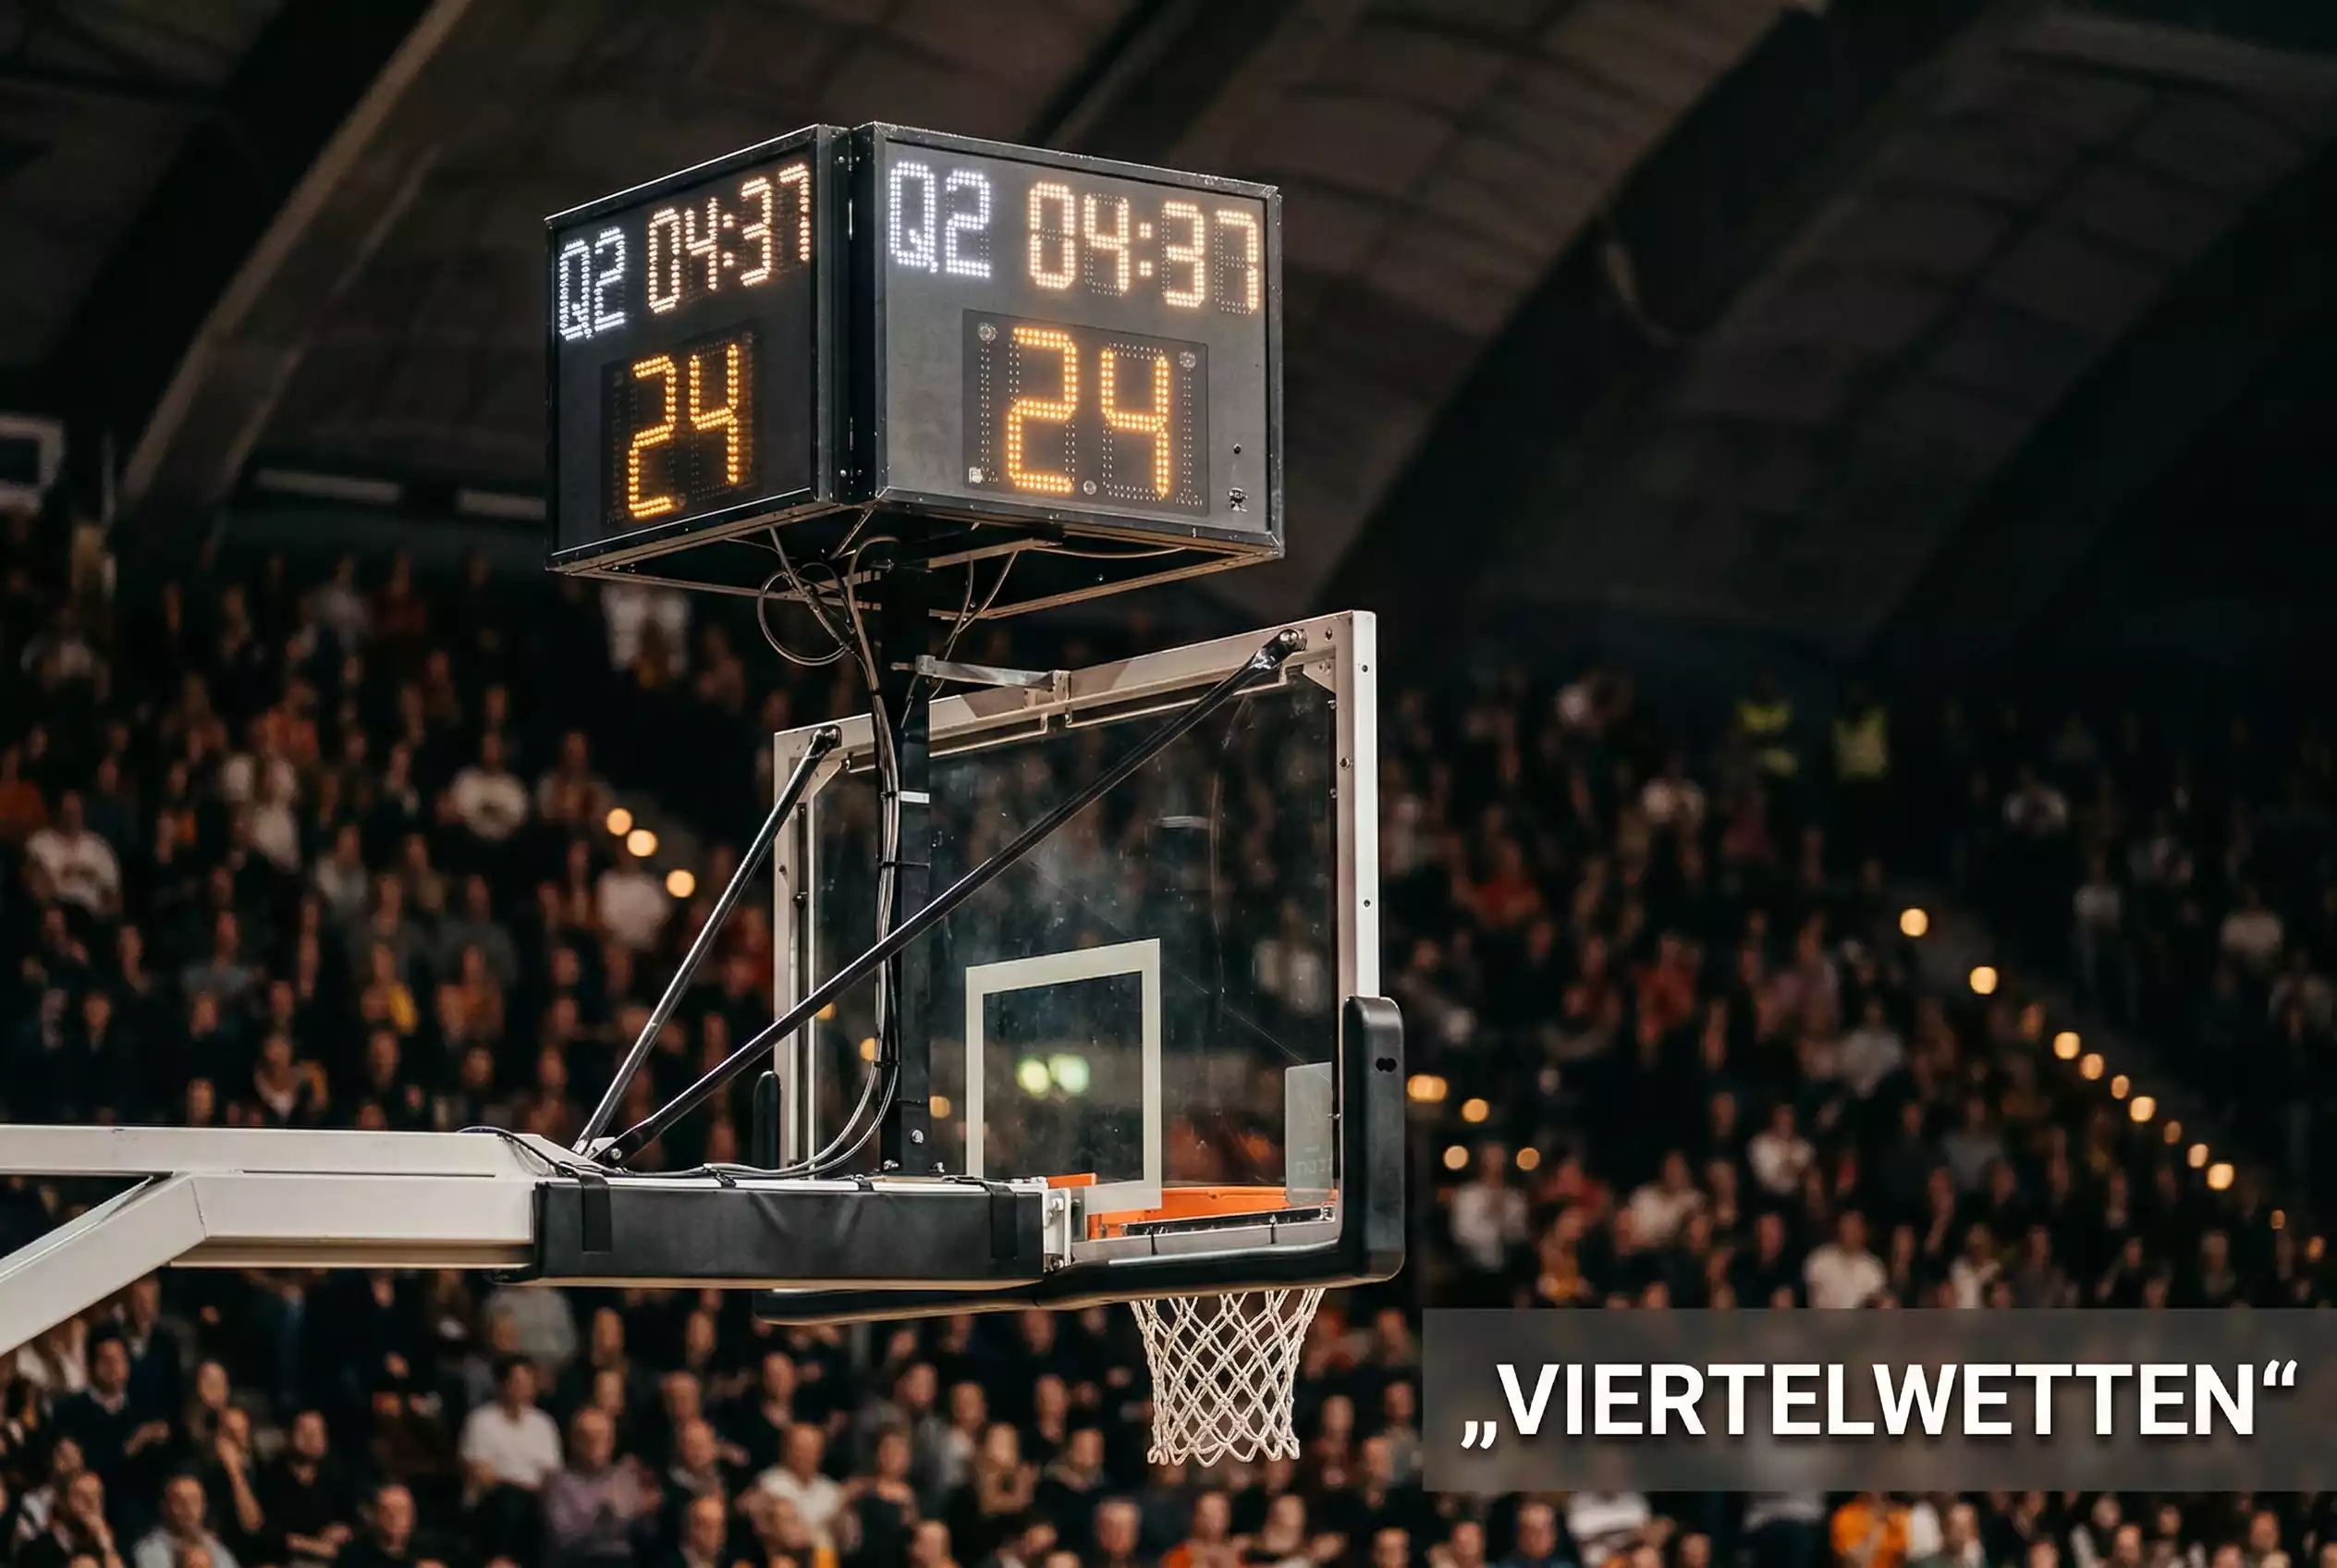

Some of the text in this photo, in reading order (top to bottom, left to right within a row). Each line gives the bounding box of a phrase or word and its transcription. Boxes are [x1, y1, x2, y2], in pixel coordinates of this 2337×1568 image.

[558, 163, 811, 342] Q2 04:37
[890, 161, 1260, 315] Q2 04:37
[629, 343, 740, 519] 24
[1007, 326, 1171, 498] 24
